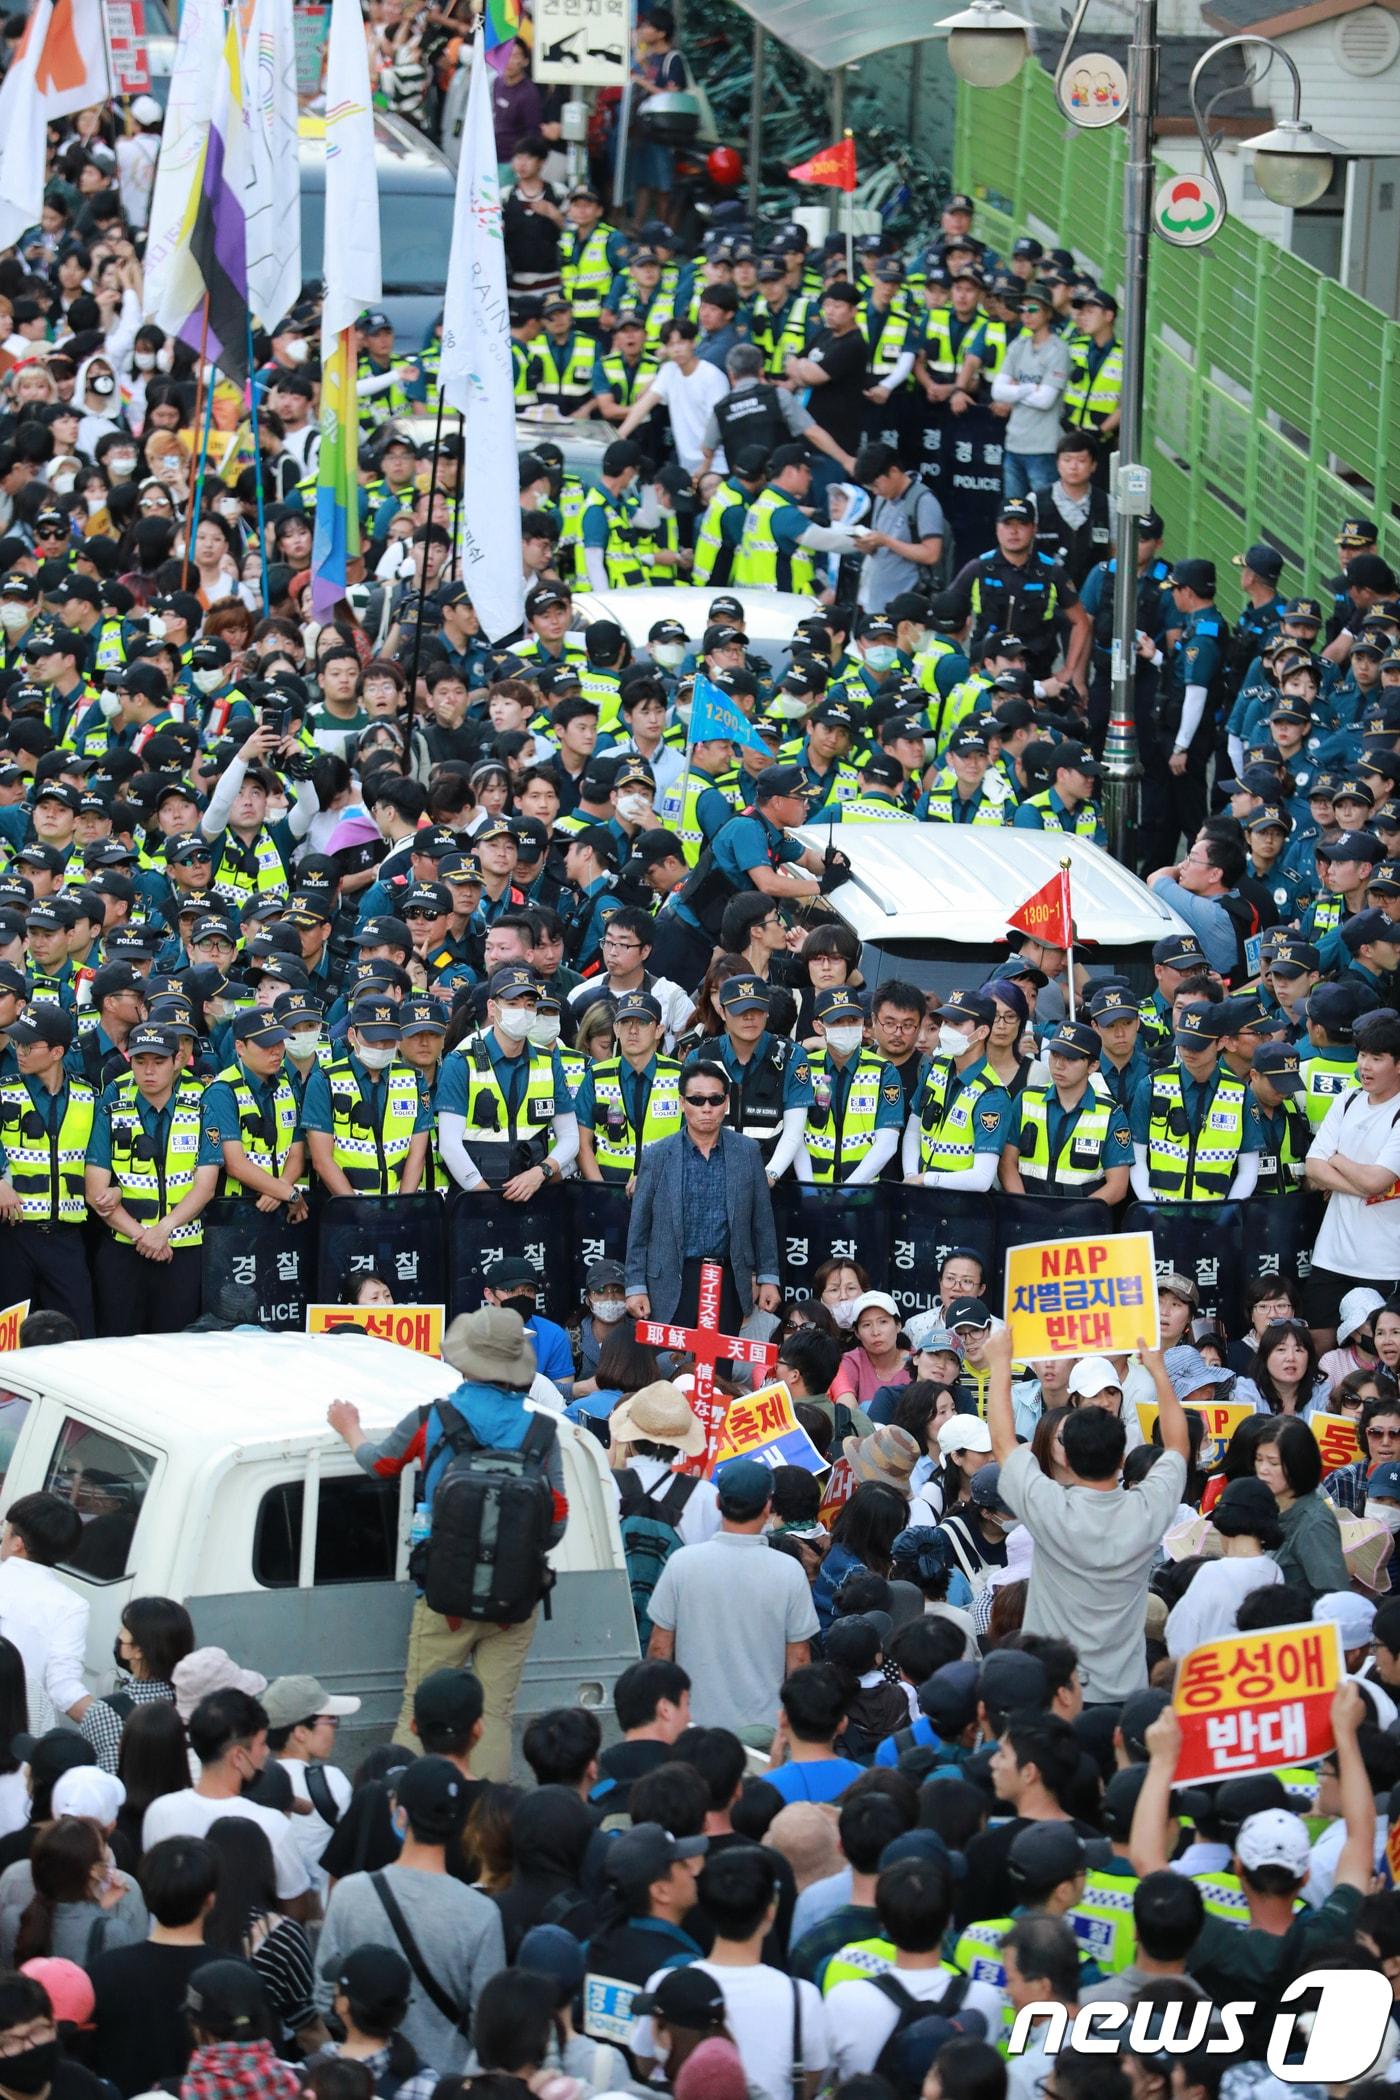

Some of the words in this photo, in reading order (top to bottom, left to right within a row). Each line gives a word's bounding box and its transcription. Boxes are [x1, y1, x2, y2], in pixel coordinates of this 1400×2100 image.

[953, 473, 1000, 491] POLICE
[869, 622, 893, 630] POLICE
[828, 708, 852, 720] POLICE
[959, 736, 984, 746] POLICE
[42, 786, 67, 797] POLICE
[177, 838, 203, 849] POLICE
[434, 836, 456, 845] POLICE
[22, 847, 46, 859] POLICE
[104, 844, 128, 853] POLICE
[0, 884, 26, 894] POLICE
[302, 879, 329, 887] POLICE
[413, 890, 437, 899] POLICE
[184, 899, 210, 907] POLICE
[258, 899, 283, 907] POLICE
[31, 906, 55, 918] POLICE
[1024, 901, 1061, 926] 1300-1
[201, 922, 227, 932] POLICE
[116, 938, 144, 947] POLICE
[137, 1036, 165, 1044] POLICE
[949, 1116, 967, 1128] POLICE
[1211, 1123, 1236, 1131] POLICE
[523, 1242, 546, 1272] 찰
[582, 1238, 606, 1266] 경
[786, 1237, 809, 1266] 경
[895, 1240, 915, 1270] 경
[232, 1255, 256, 1285] 경
[276, 1250, 300, 1281] 찰
[395, 1250, 420, 1281] 찰
[1041, 1246, 1108, 1278] NAP
[1195, 1257, 1220, 1287] 찰
[699, 1267, 720, 1329] 主イエスを
[1012, 1275, 1143, 1314] 차별금지법
[1046, 1312, 1113, 1352] 반대
[727, 1340, 767, 1364] 天国
[1182, 1635, 1325, 1708] 동성애
[1206, 1702, 1308, 1769] 반대
